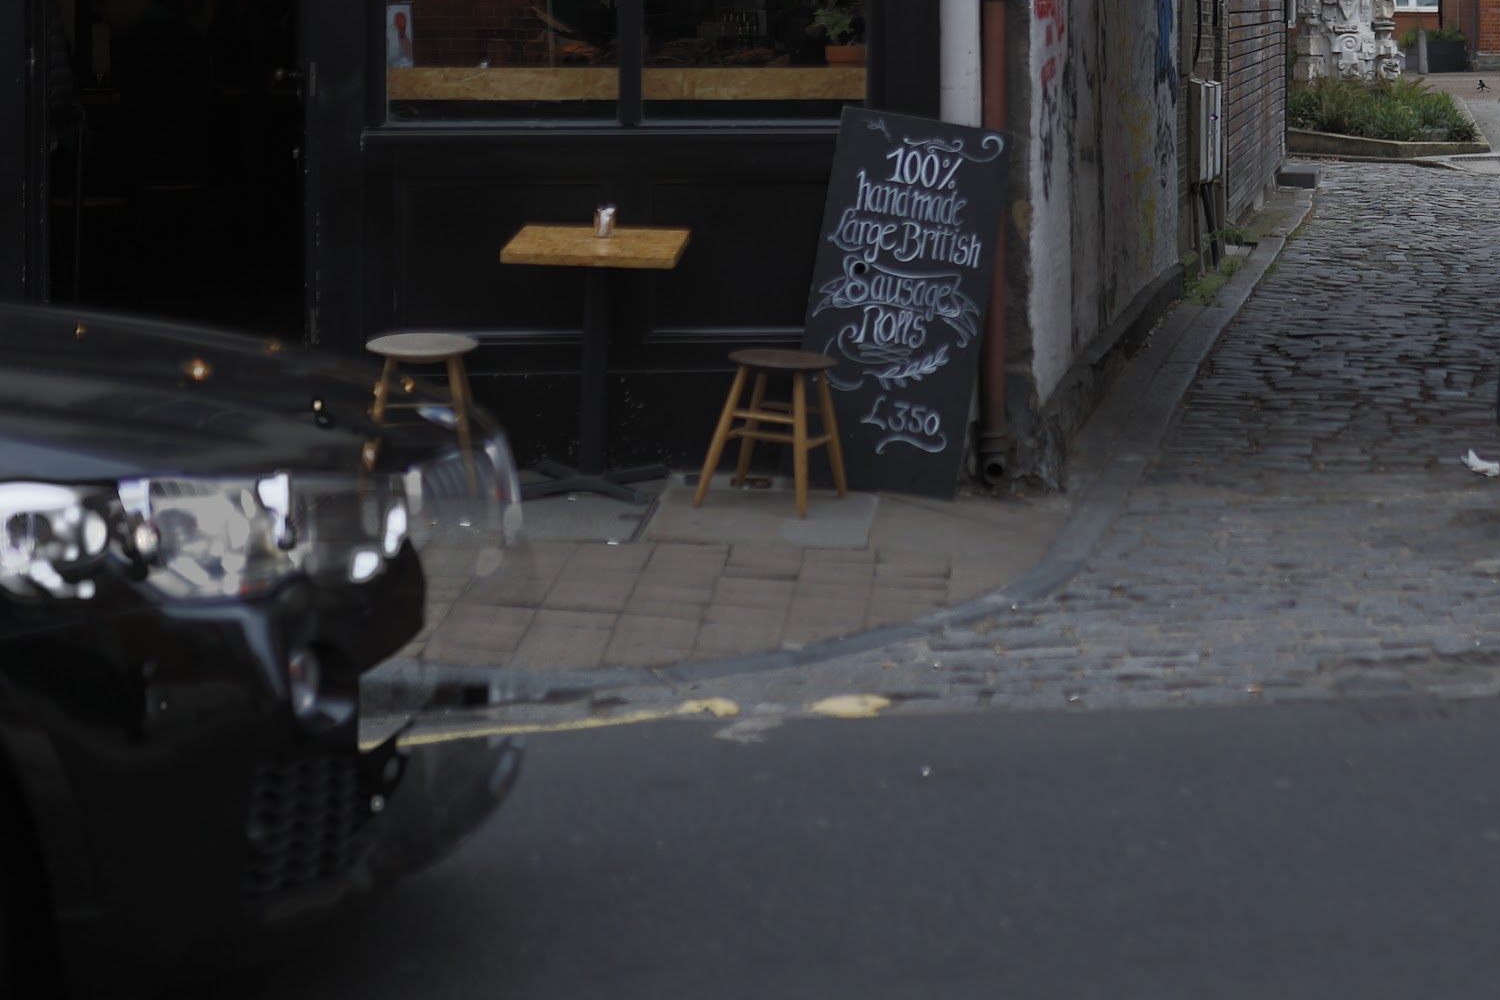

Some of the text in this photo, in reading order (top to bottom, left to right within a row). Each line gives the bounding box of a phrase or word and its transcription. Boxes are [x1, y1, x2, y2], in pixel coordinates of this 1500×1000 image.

[885, 147, 964, 191] 100%
[855, 170, 967, 226] handmade
[827, 208, 981, 269] Large British
[844, 260, 952, 322] Sausage
[852, 305, 926, 349] Rolls
